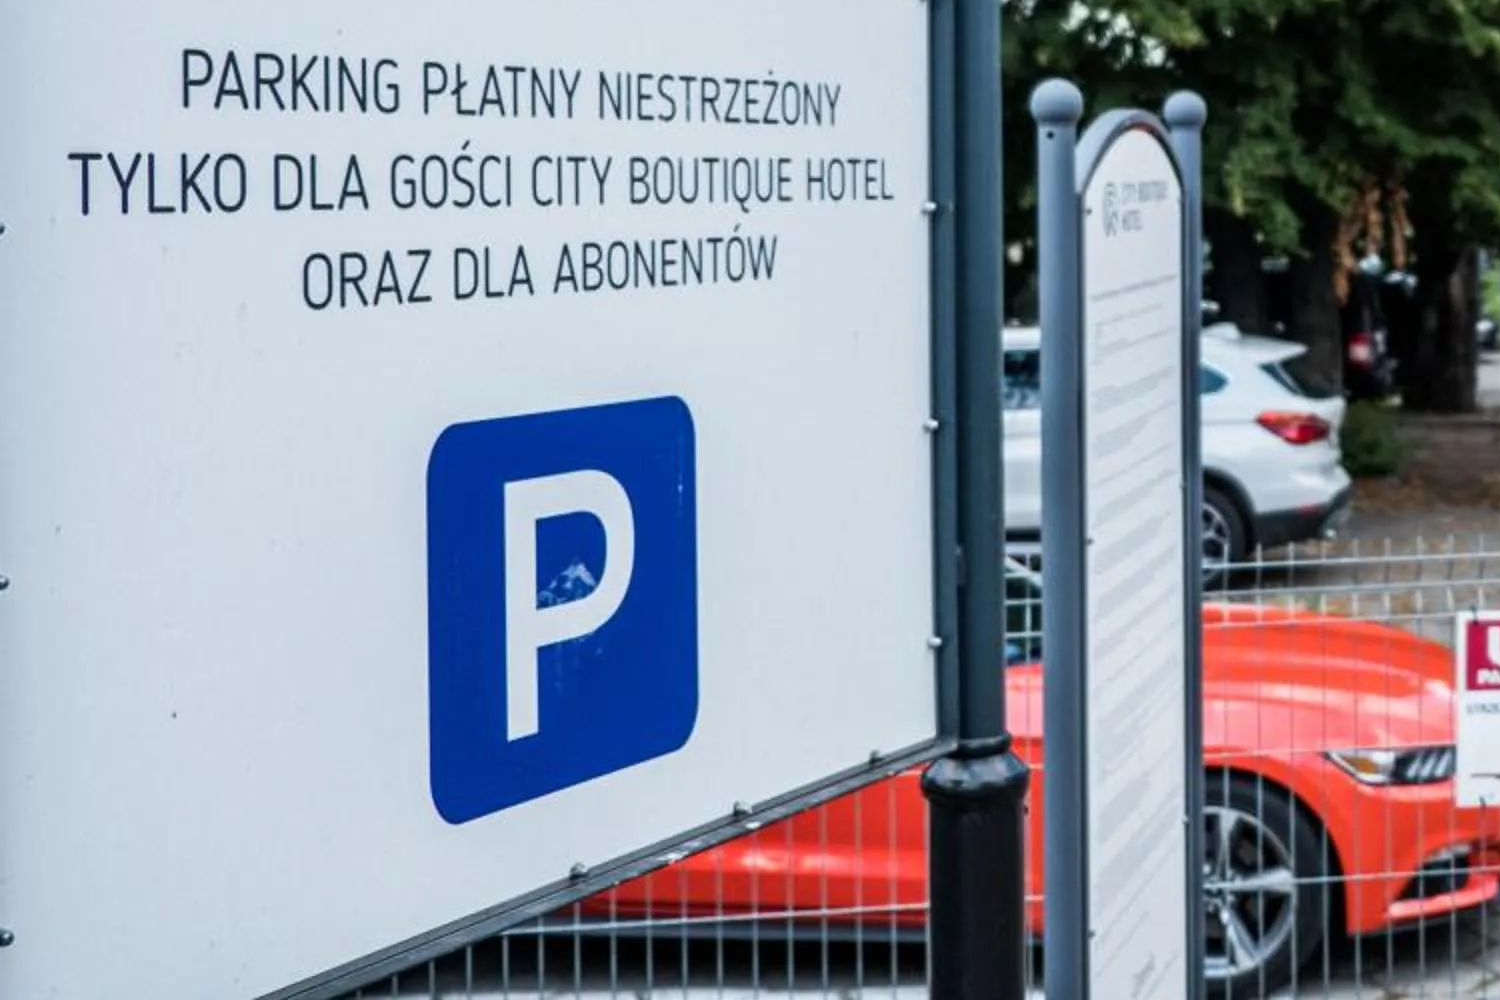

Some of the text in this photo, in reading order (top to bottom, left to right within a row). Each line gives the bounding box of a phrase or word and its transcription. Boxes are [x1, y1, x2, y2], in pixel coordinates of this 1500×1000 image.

[182, 48, 841, 126] PARKING PŁATNY NIESTRZEŻONY
[67, 139, 895, 217] TYLKO DLA GOŚCI CITY BOUTIQUE HOTEL
[302, 225, 778, 311] ORAZ DLA ABONENTÓW
[503, 468, 635, 742] P
